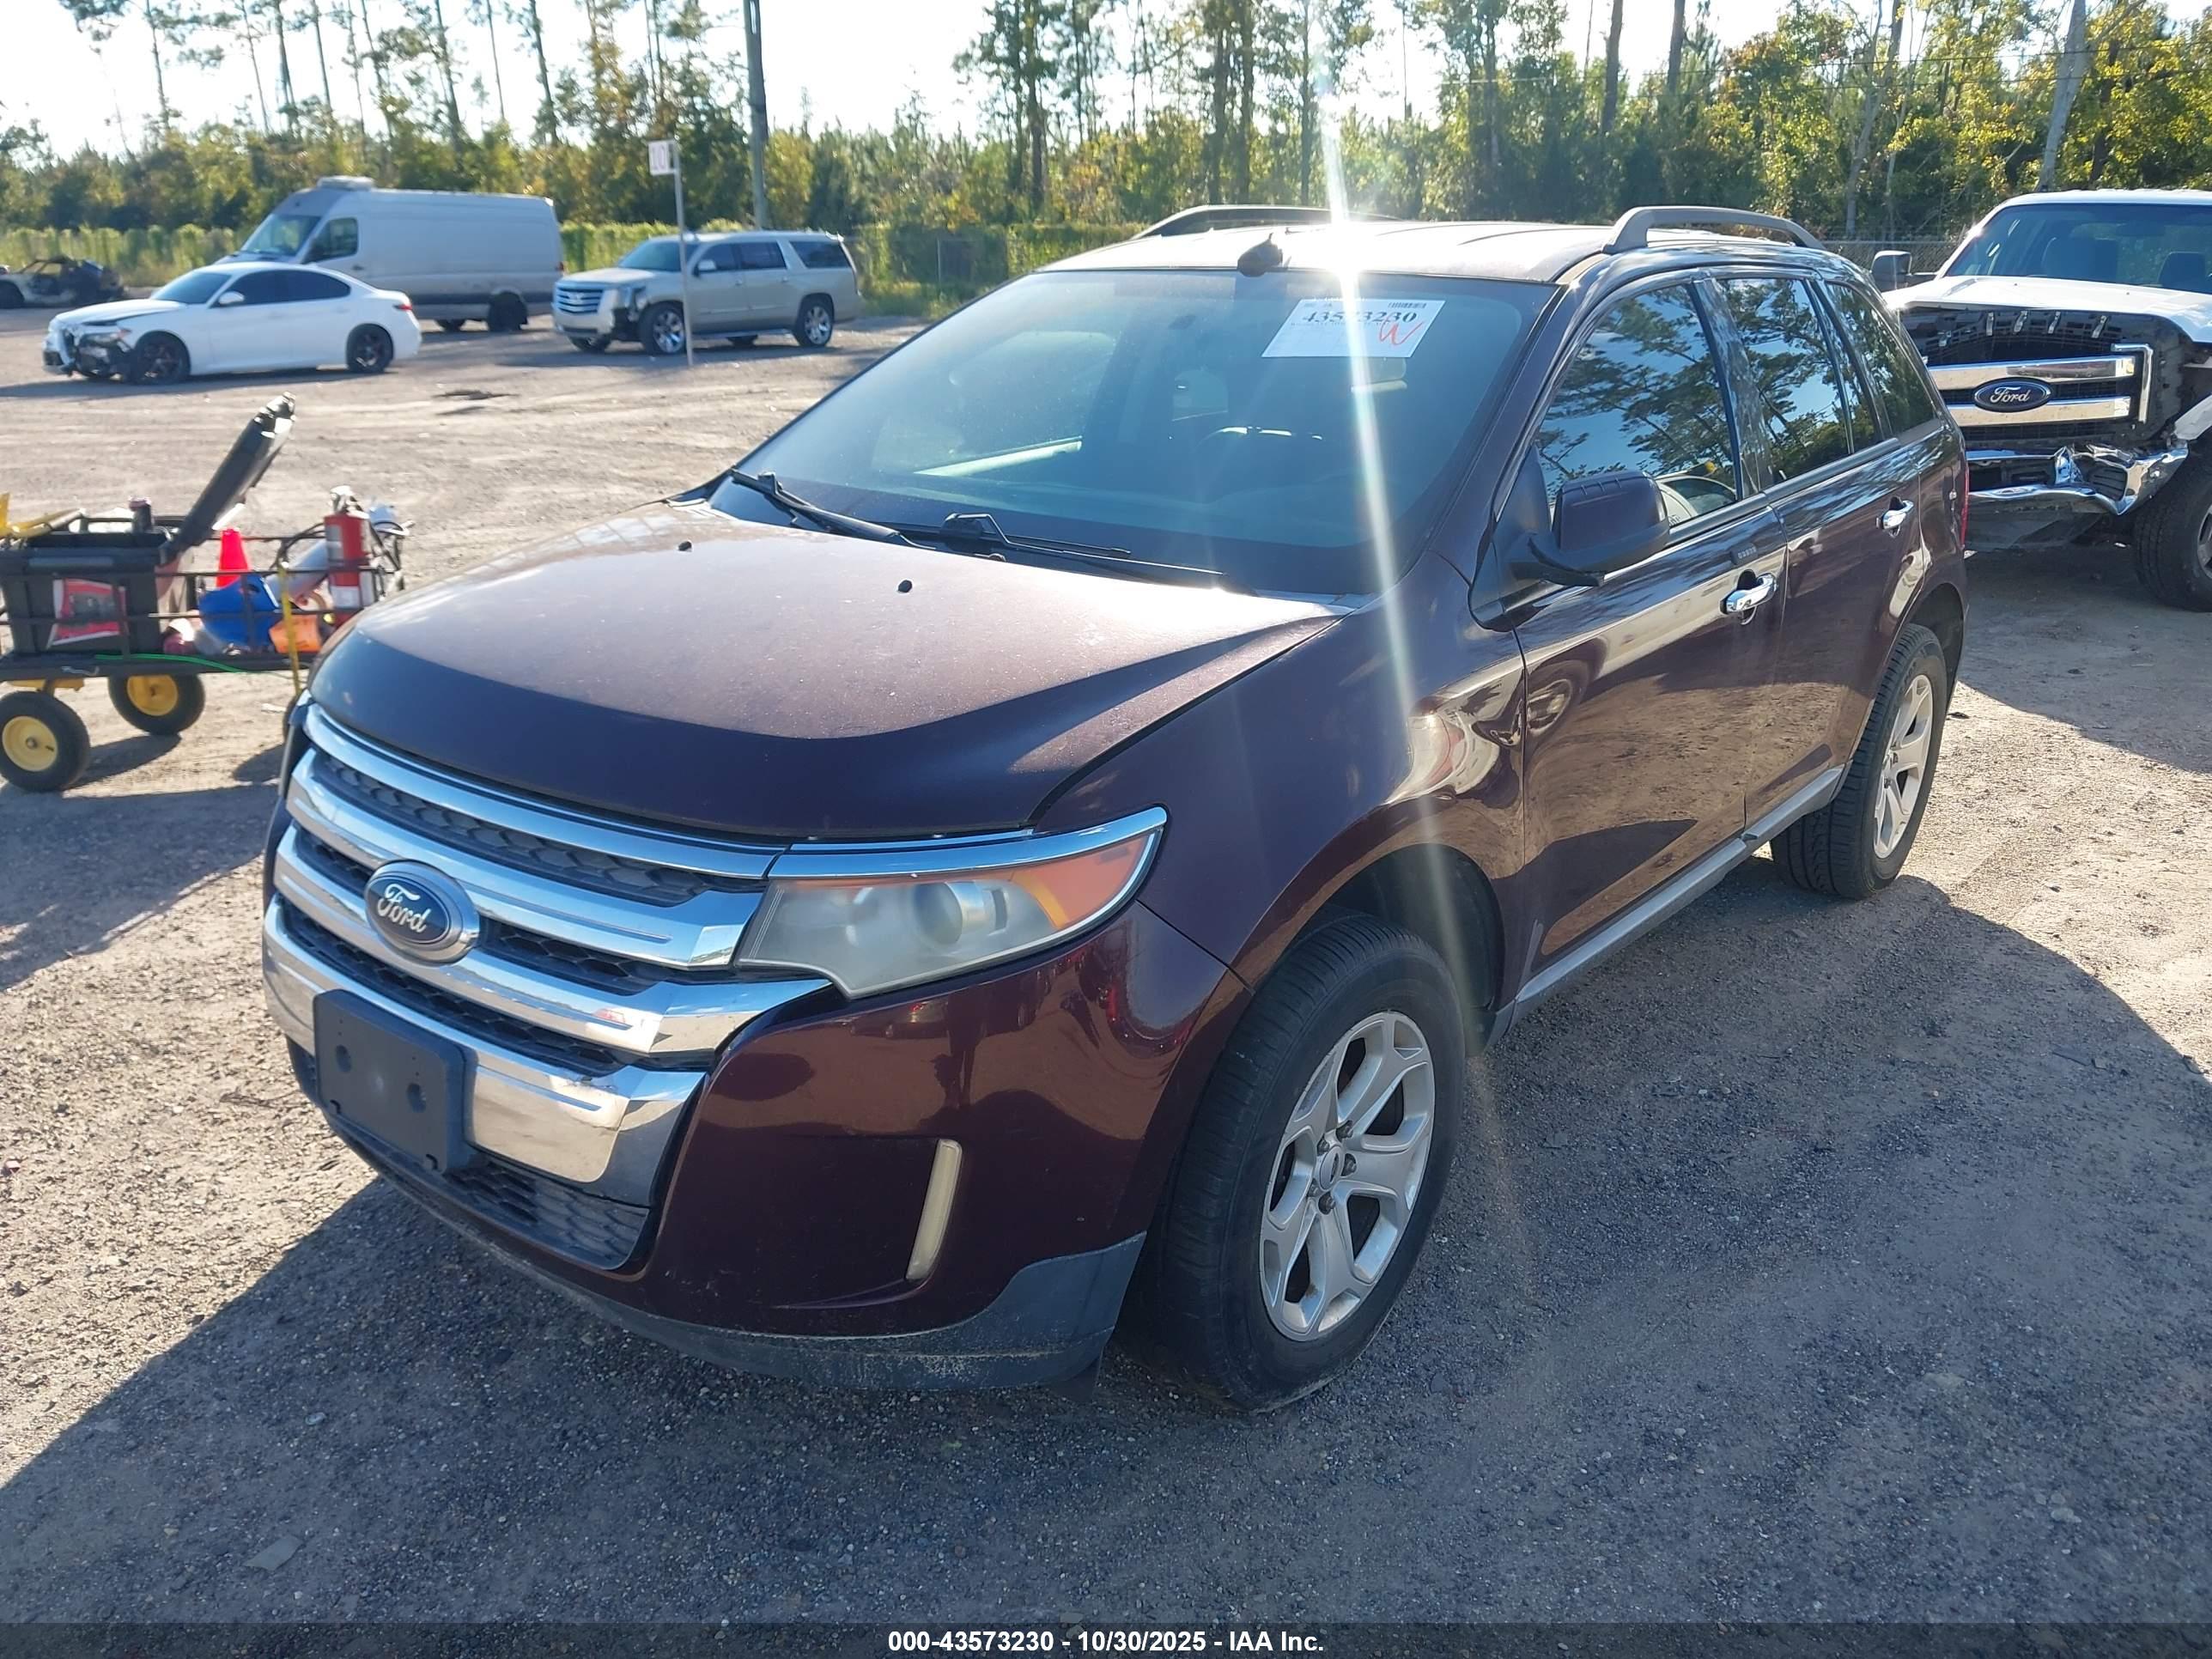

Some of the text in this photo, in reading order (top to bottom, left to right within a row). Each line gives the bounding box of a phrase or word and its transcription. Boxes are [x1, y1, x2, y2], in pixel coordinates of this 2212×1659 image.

[1302, 311, 1418, 323] 4353230
[1990, 386, 2031, 403] Ford
[377, 883, 431, 933] Ford
